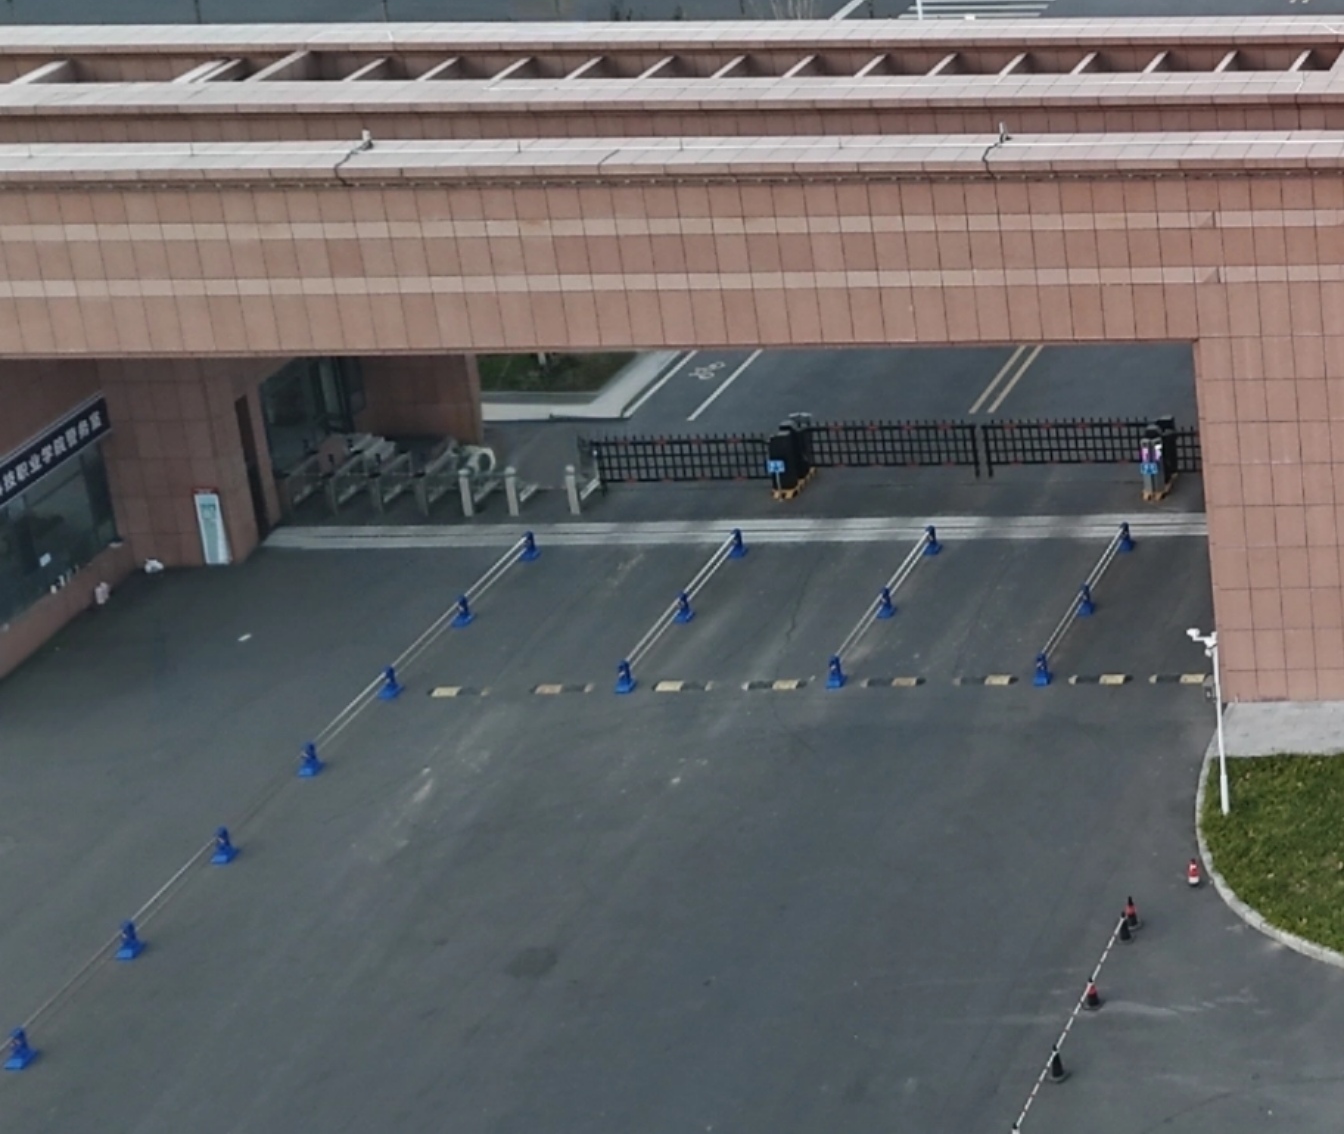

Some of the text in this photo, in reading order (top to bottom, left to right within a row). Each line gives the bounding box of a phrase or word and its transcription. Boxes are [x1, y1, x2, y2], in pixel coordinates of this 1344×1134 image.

[0, 410, 102, 494] 技职业学院警务室
